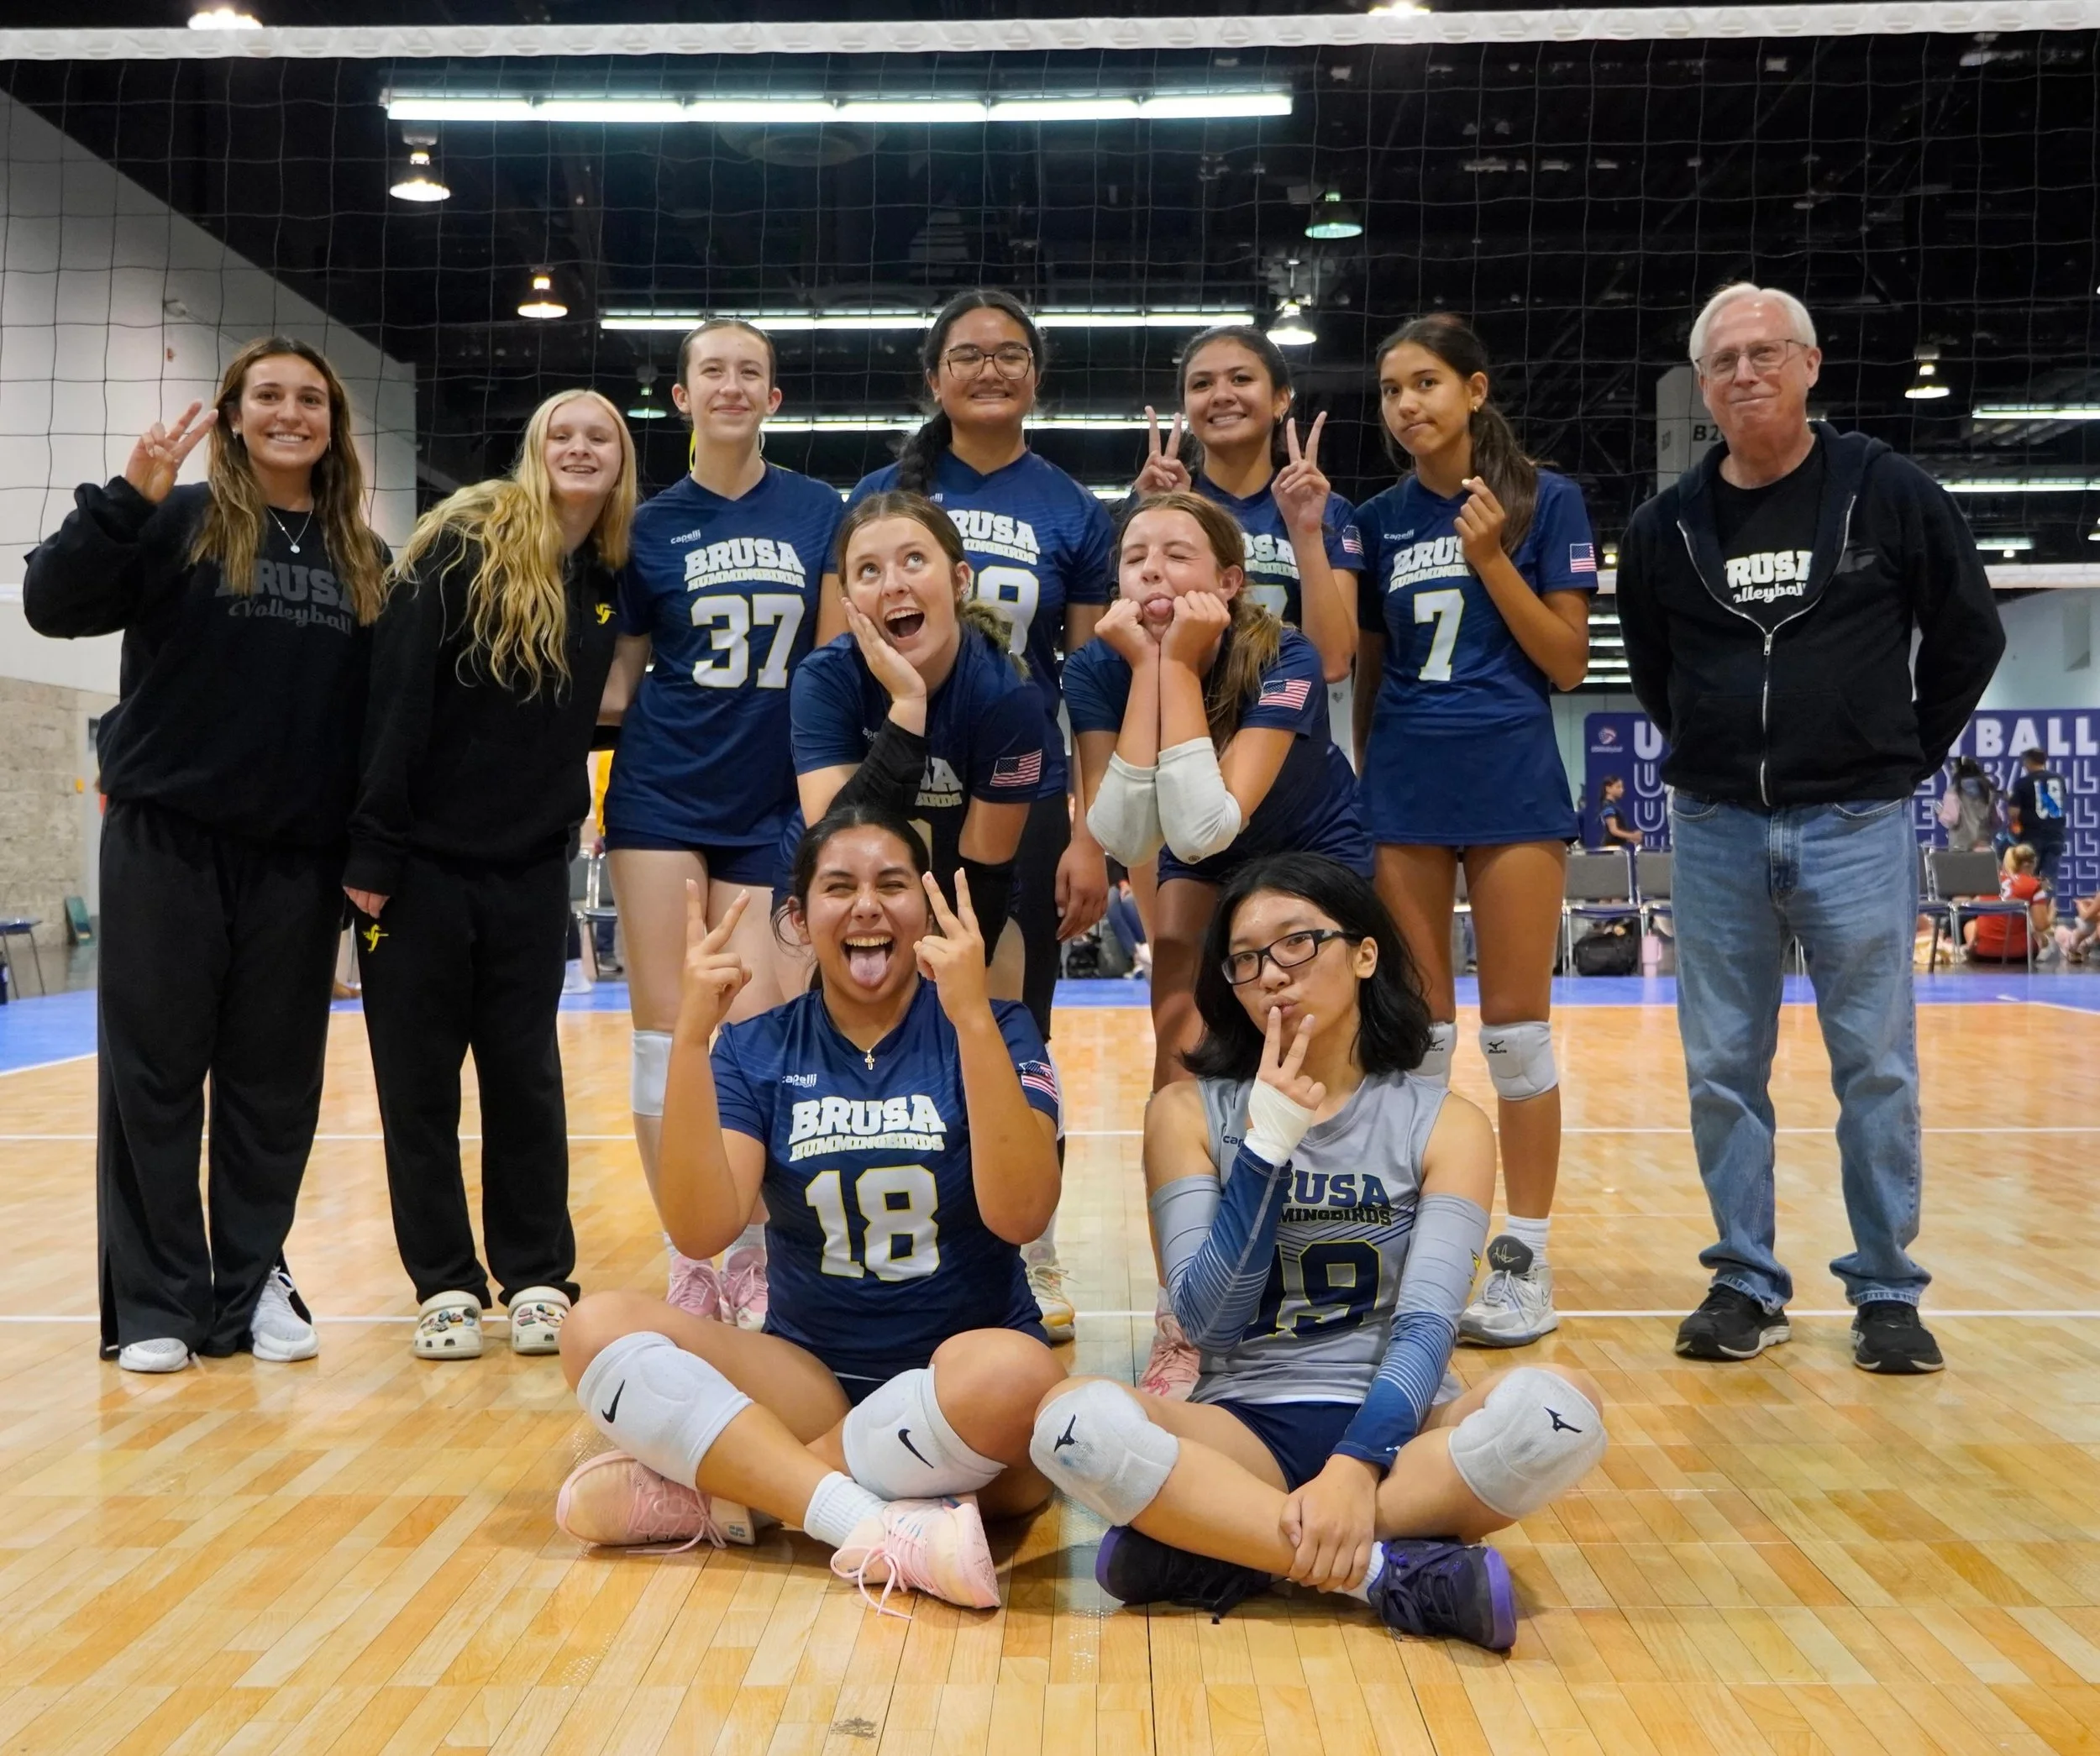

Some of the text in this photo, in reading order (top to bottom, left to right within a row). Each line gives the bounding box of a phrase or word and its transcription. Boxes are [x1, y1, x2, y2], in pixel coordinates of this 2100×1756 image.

[670, 529, 701, 544] capelli
[1383, 529, 1415, 541] capelli
[684, 537, 806, 581] BRUSA
[690, 594, 806, 689] 37
[1413, 589, 1465, 681] 7
[788, 1094, 948, 1145] BRUSA
[788, 1133, 945, 1162] HUMMINGBIRDS
[805, 1164, 941, 1282] 18
